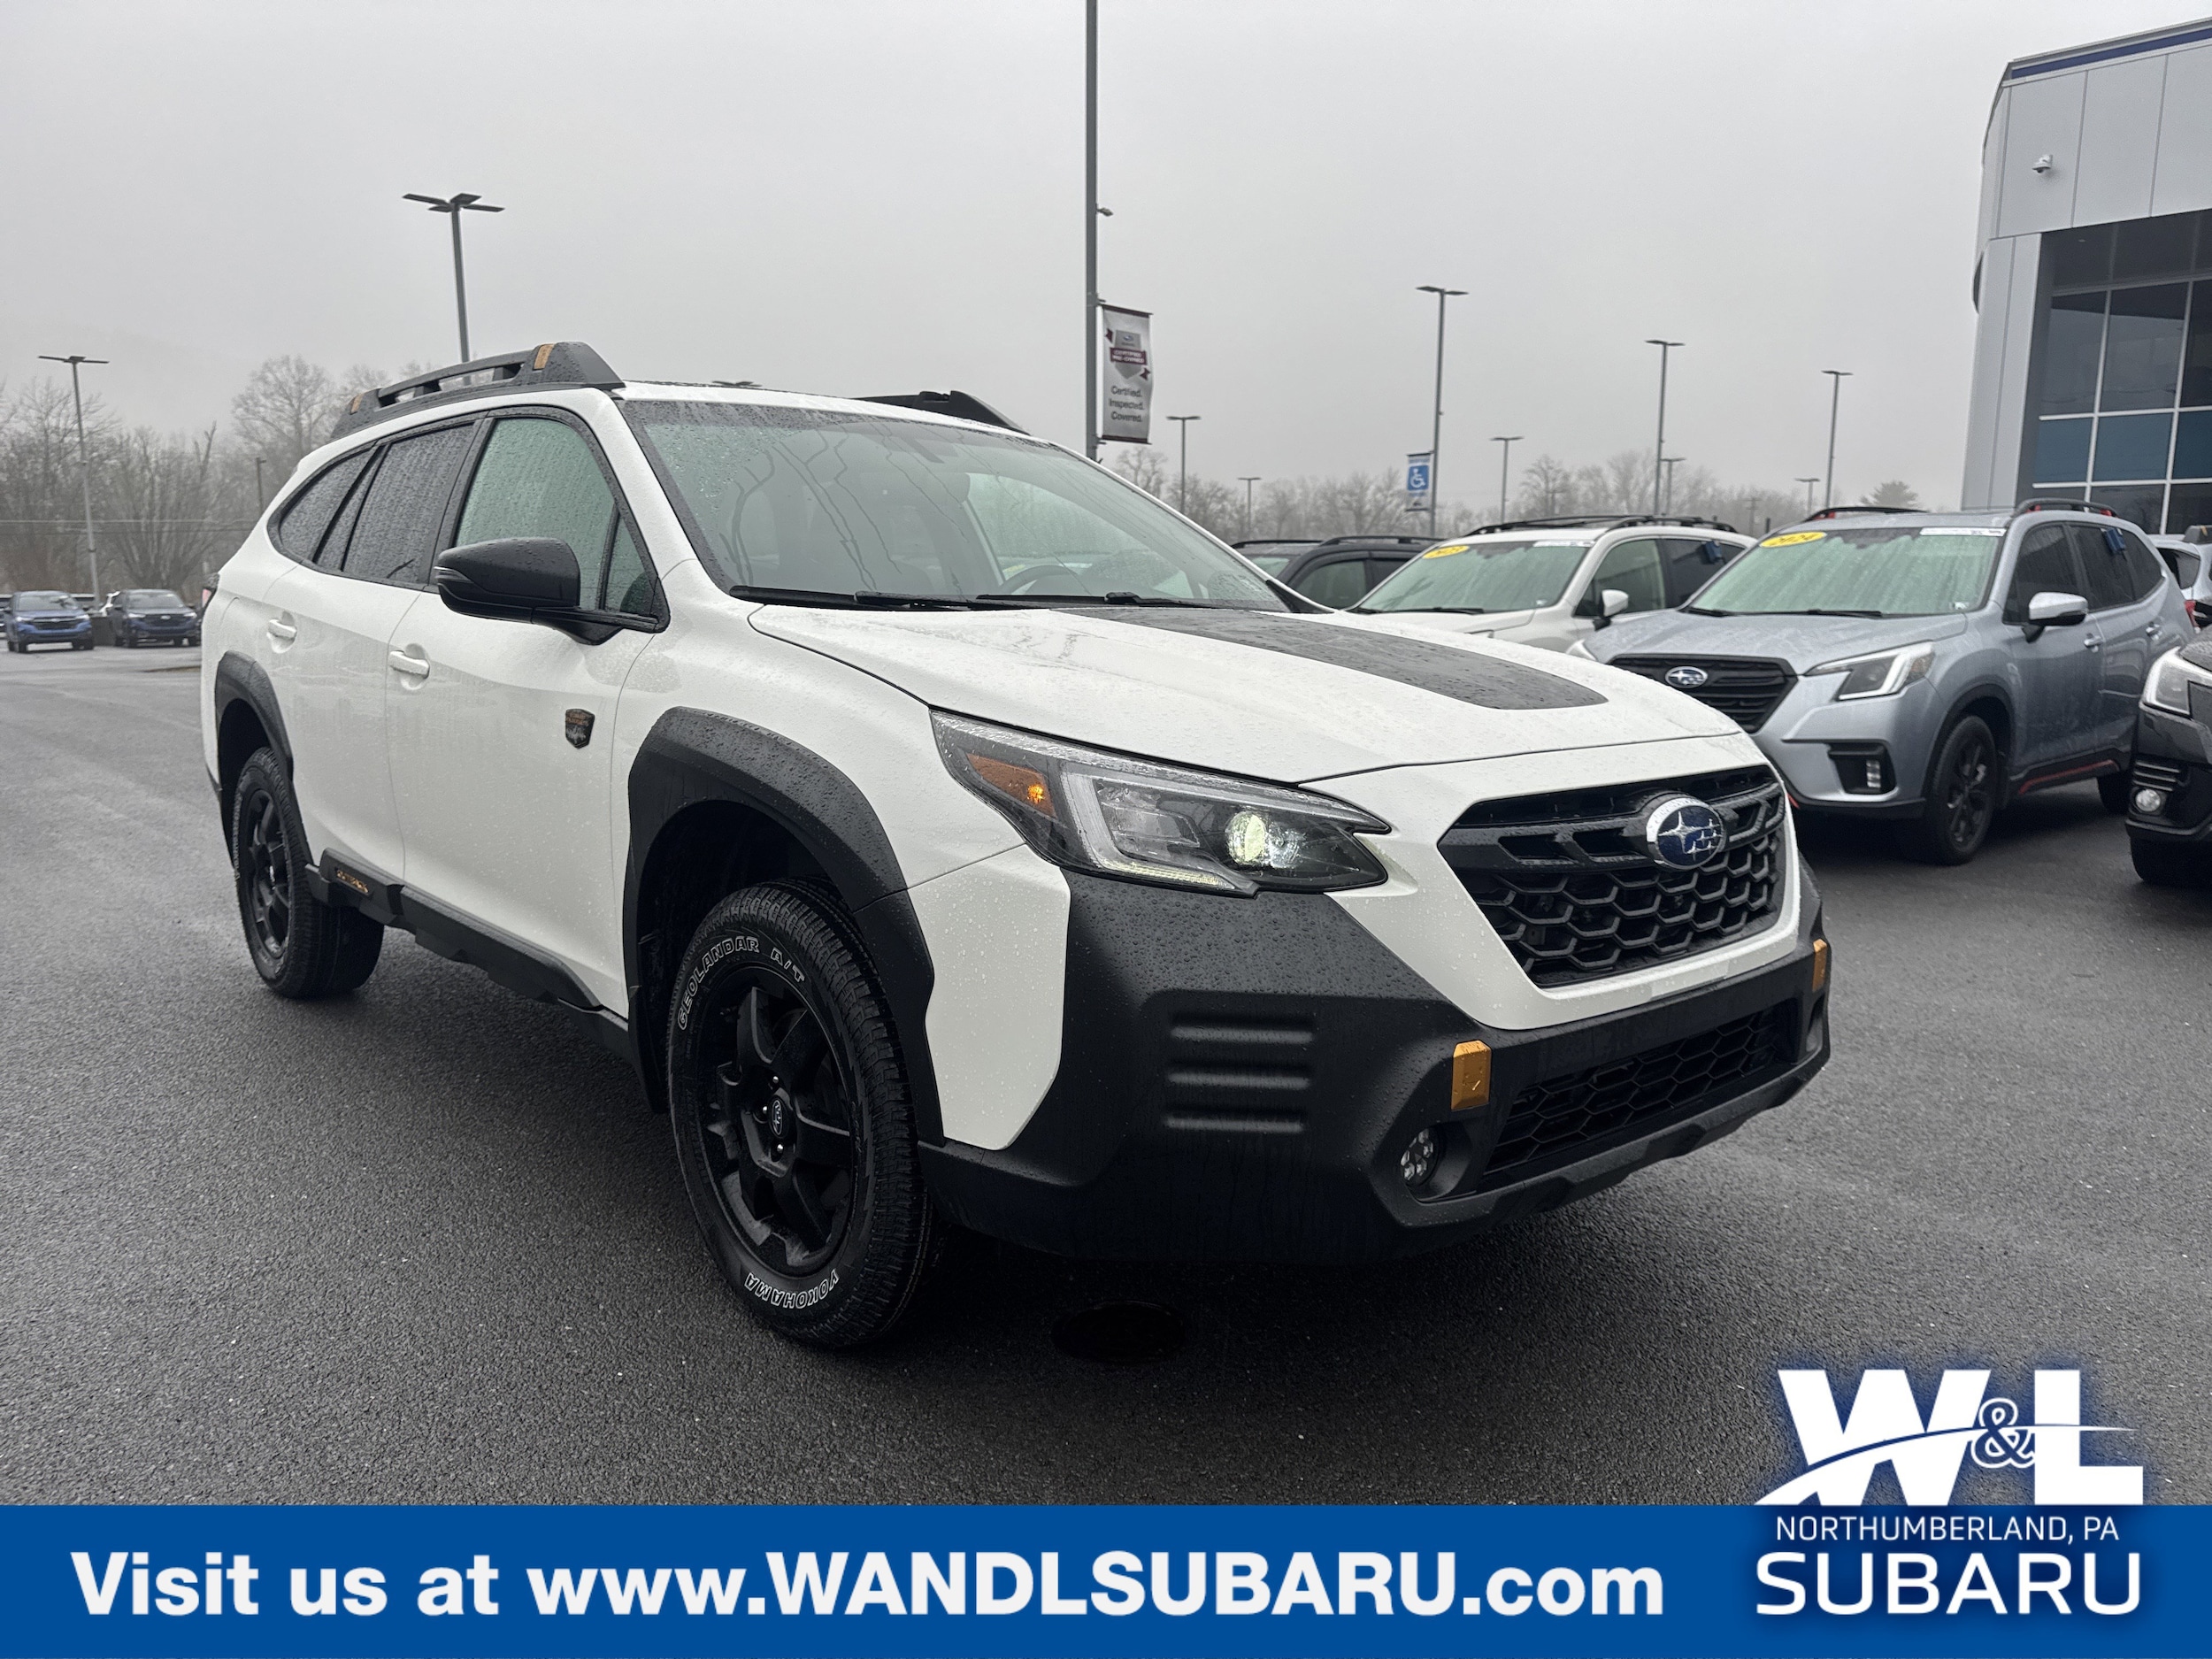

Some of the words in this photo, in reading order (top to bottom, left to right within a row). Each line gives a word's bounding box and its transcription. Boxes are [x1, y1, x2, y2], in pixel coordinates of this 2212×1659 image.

[1110, 385, 1142, 397] Certified.
[1109, 398, 1145, 411] Inspected.
[1110, 411, 1142, 423] Covered.
[677, 935, 760, 1031] GEOLANDAR
[744, 1268, 840, 1310] YOKOHAMA
